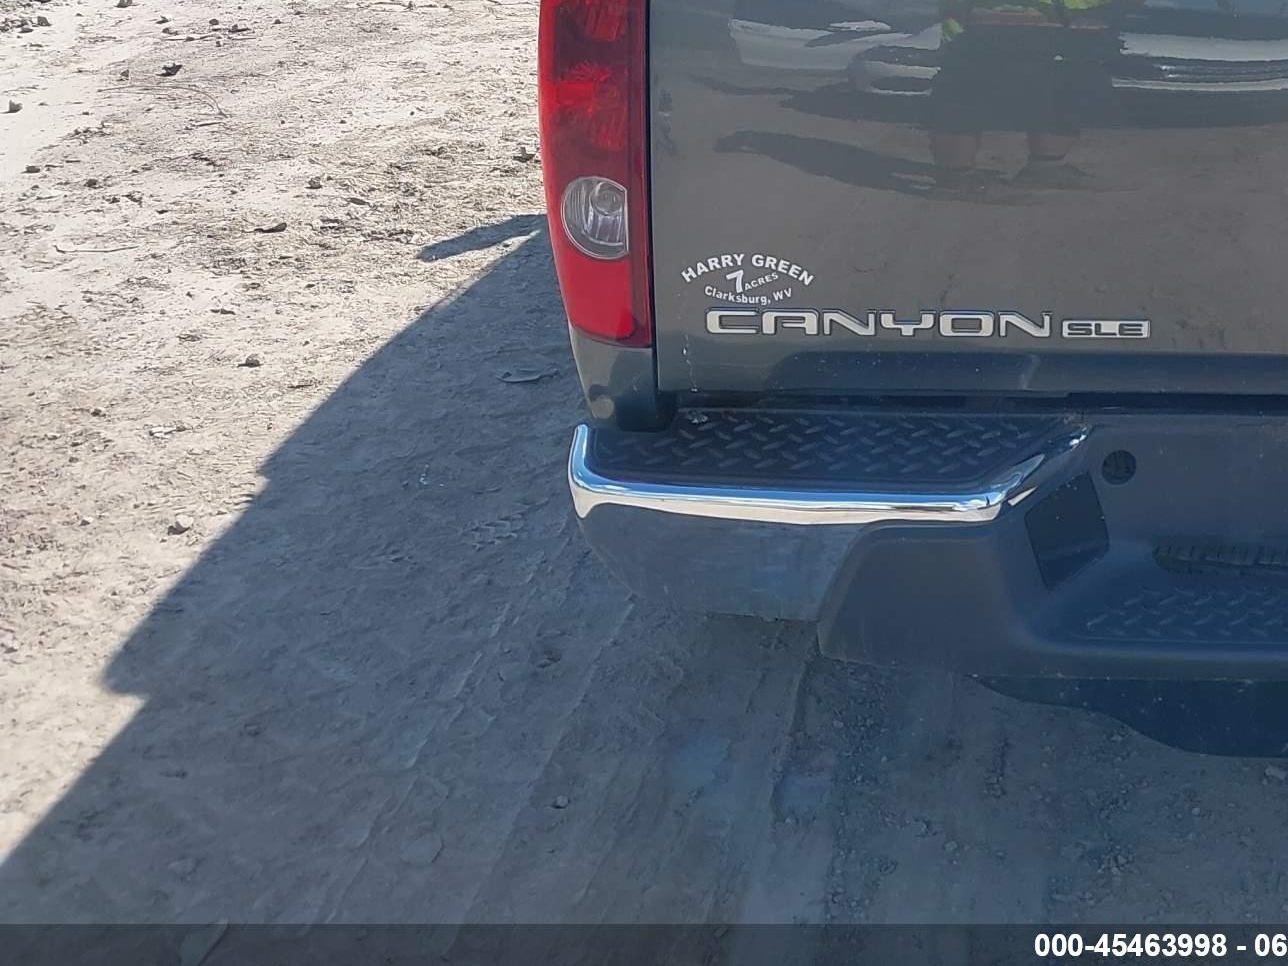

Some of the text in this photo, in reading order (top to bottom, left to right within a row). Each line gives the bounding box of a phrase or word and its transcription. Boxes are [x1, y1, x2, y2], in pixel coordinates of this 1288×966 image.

[681, 253, 814, 286] HARRY GREEN
[726, 269, 779, 294] 7 ACRES
[704, 285, 793, 306] Clarksburg, WV
[705, 308, 1147, 338] CANYON SLE
